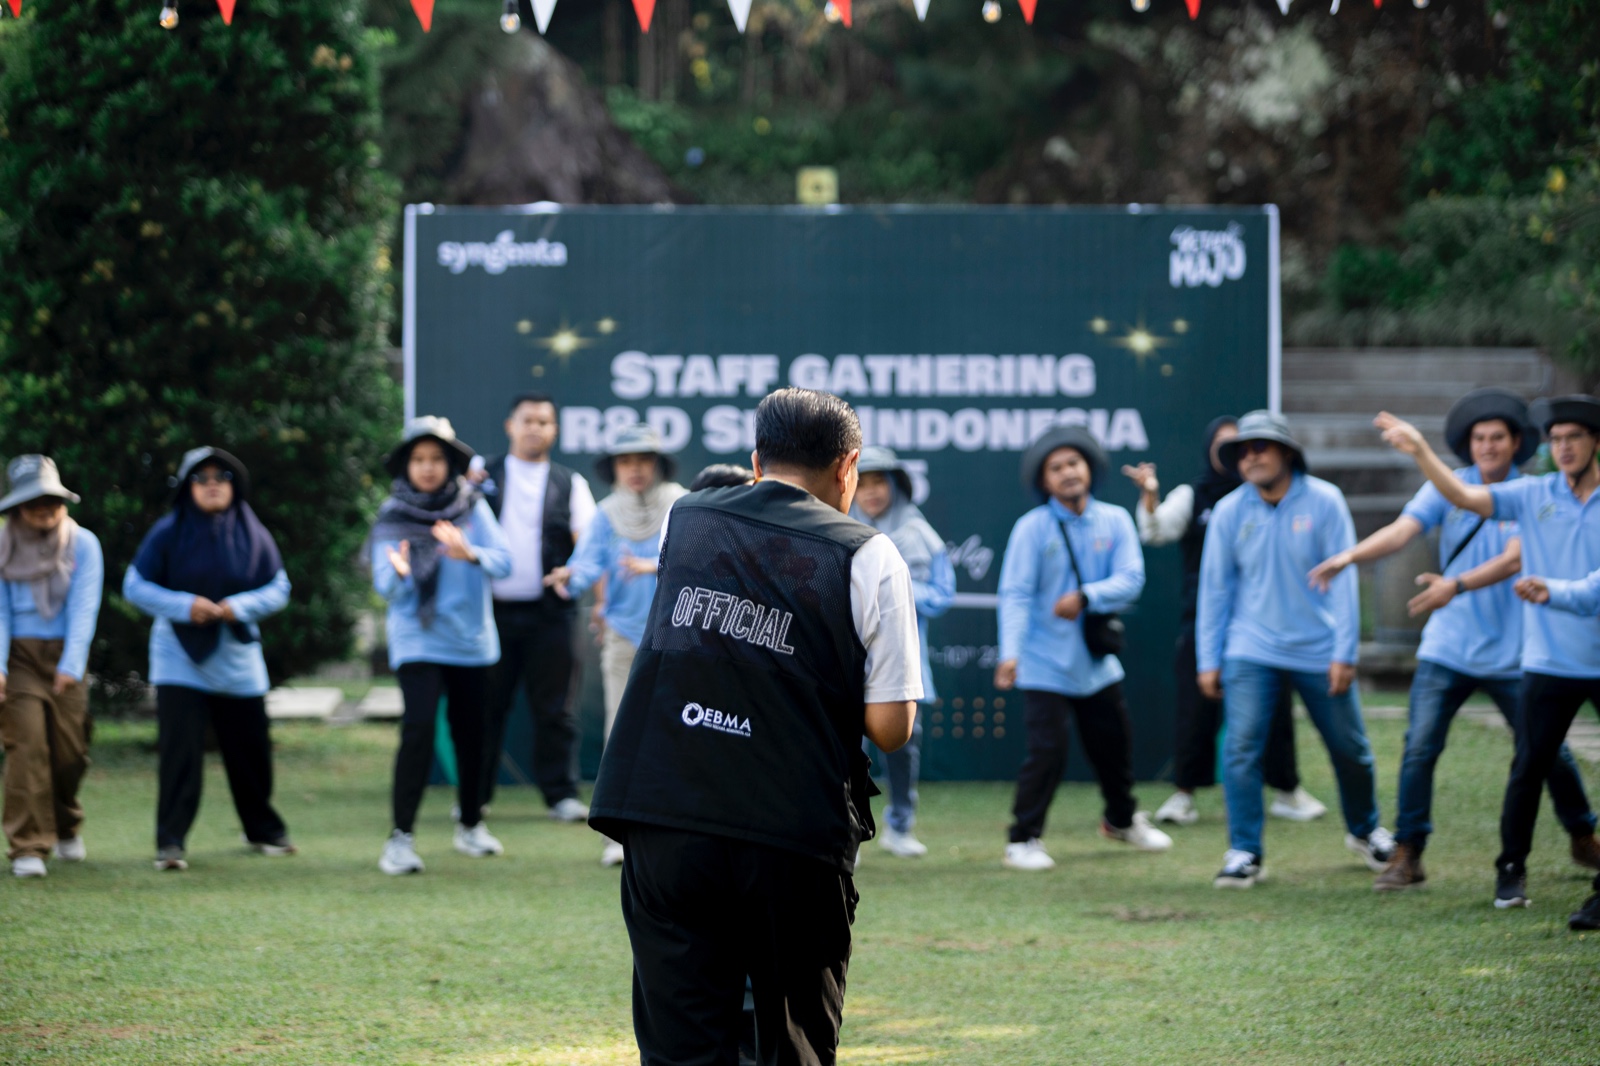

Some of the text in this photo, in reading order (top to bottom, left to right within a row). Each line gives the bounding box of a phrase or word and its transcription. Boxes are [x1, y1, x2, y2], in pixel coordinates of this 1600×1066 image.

[437, 230, 568, 275] syngenta
[610, 351, 1096, 399] STAFF GATHERING
[560, 405, 692, 454] R&D
[672, 586, 794, 655] OFFICIAL
[703, 707, 752, 732] EBMA
